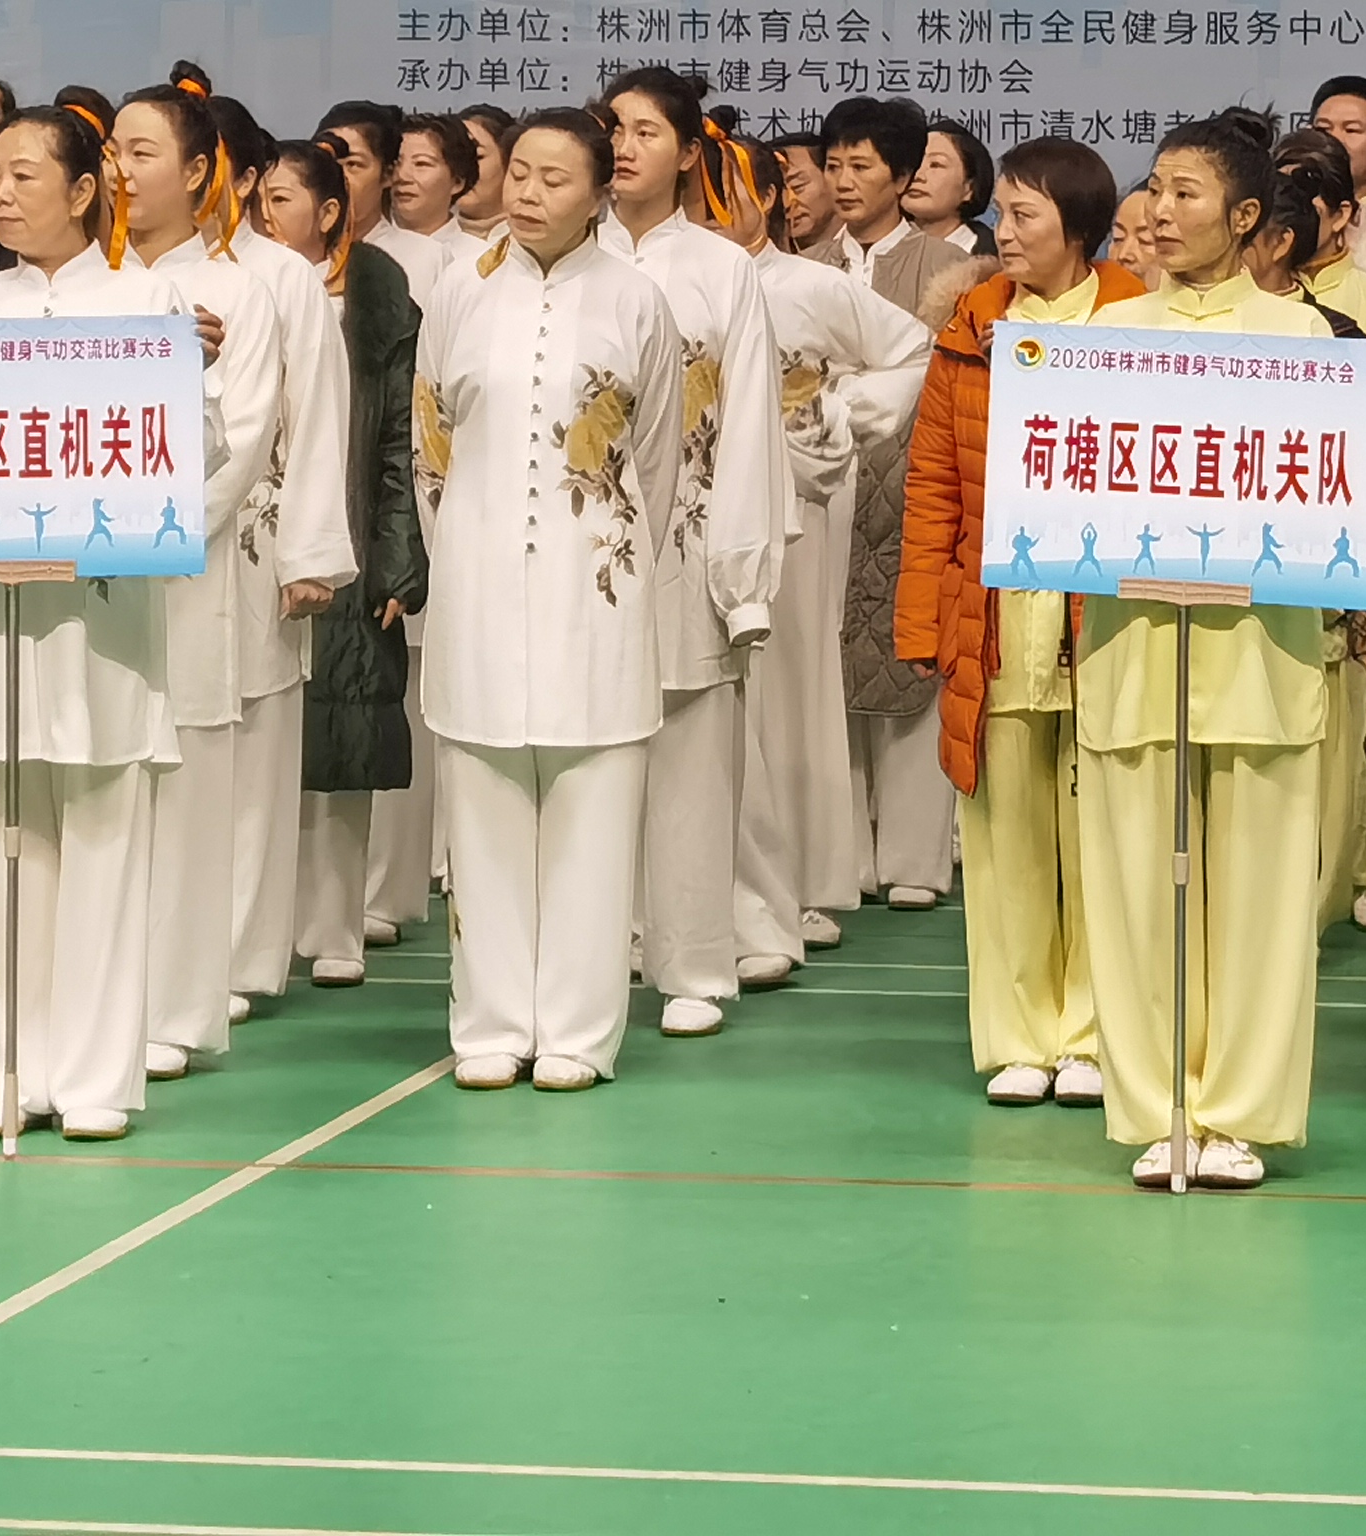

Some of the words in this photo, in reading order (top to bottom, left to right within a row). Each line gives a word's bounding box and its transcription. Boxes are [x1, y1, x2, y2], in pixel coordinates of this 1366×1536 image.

[1049, 347, 1355, 384] 2020年株洲市健身气功交流比赛大会
[1022, 414, 1353, 506] 荷塘区区直机关队
